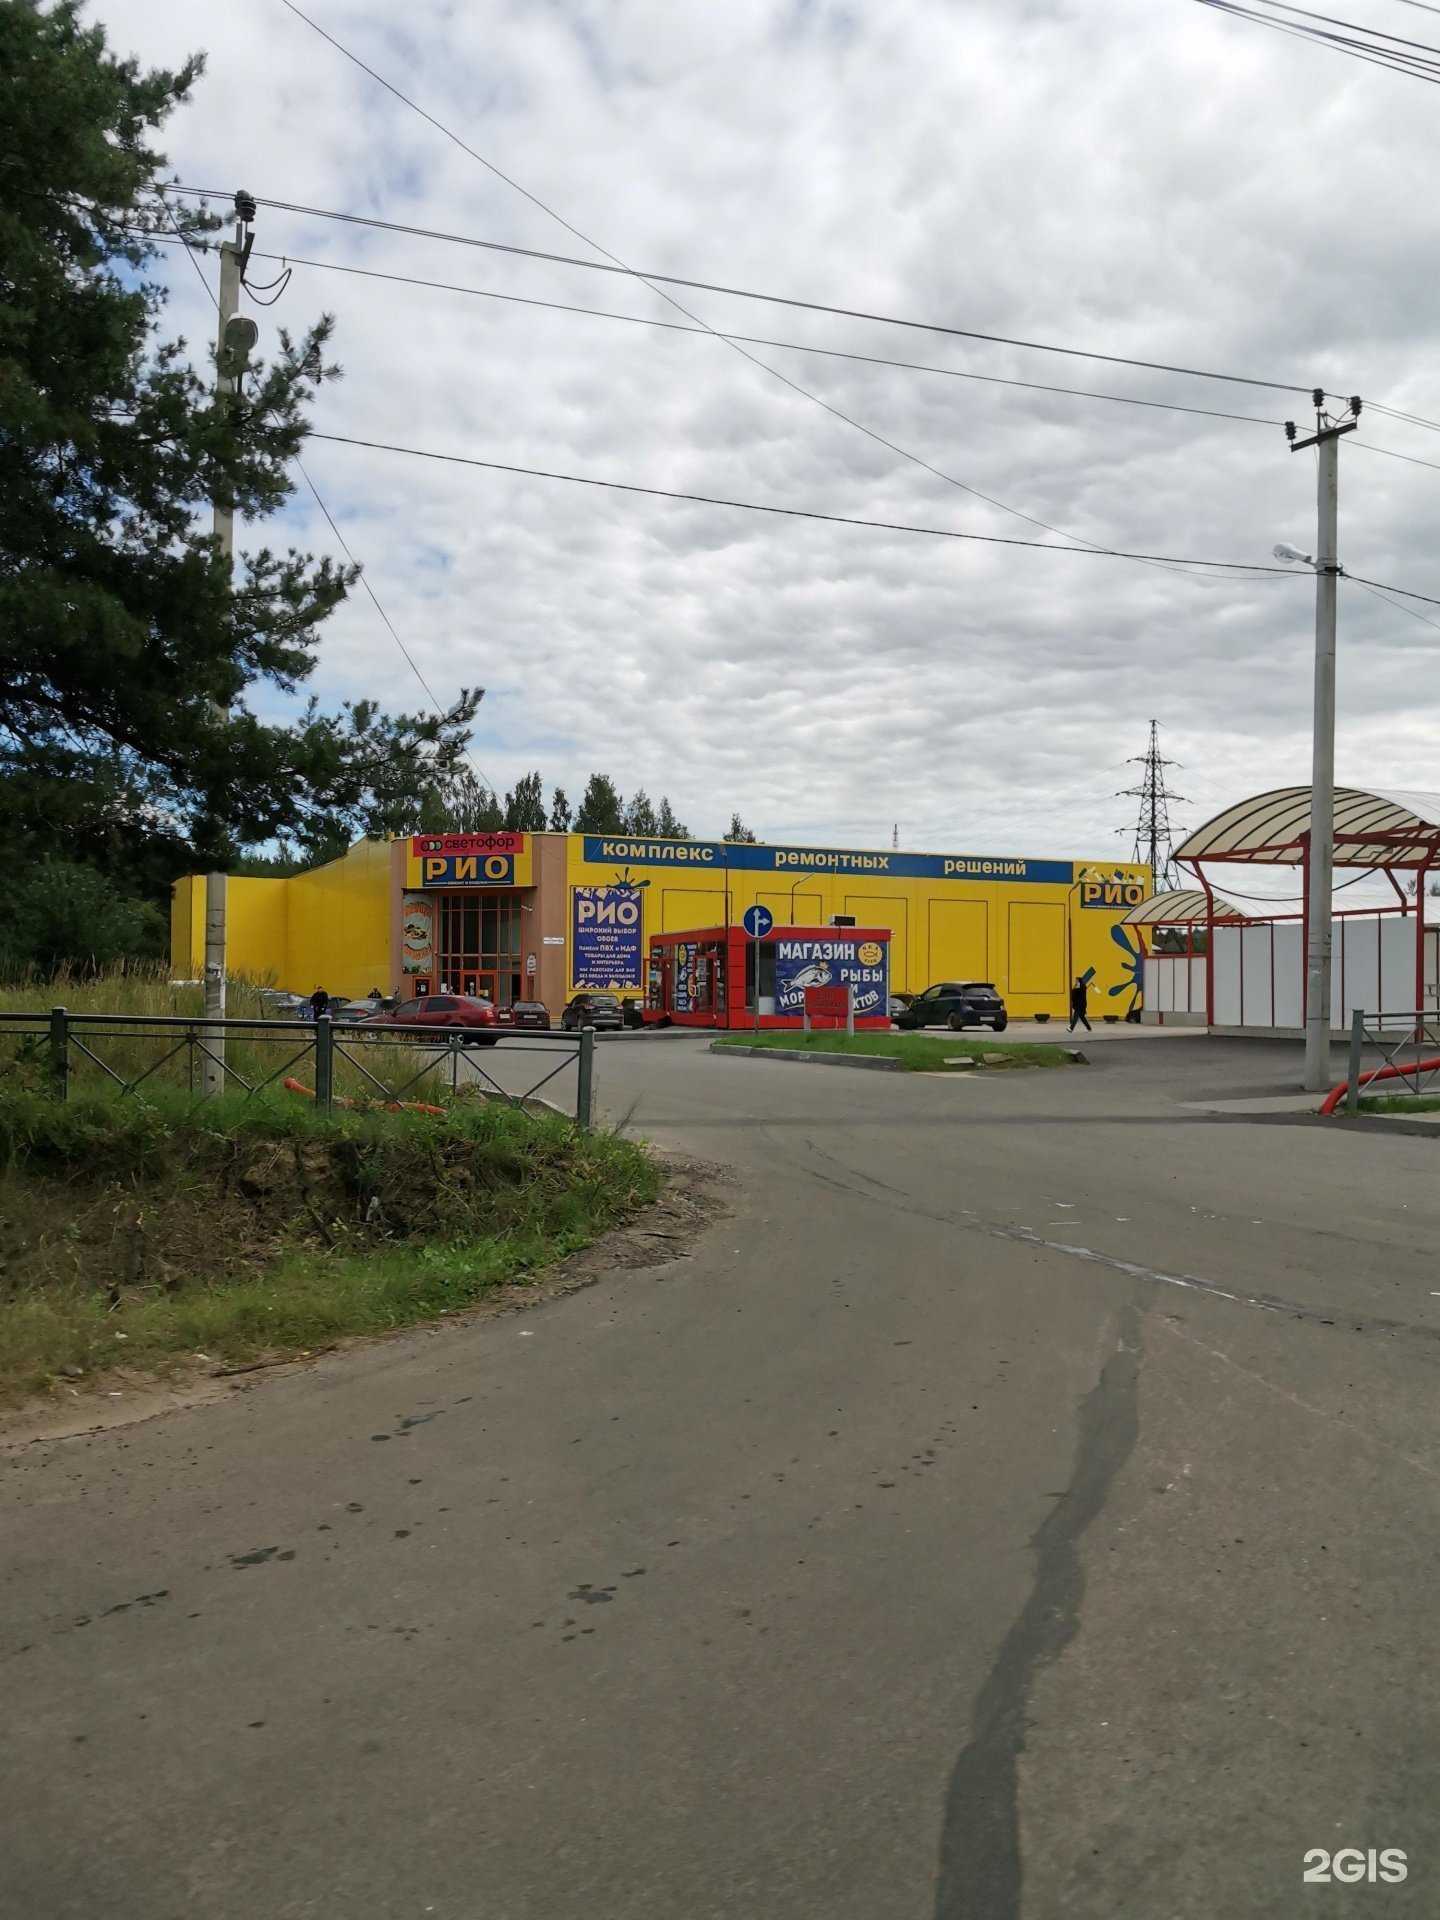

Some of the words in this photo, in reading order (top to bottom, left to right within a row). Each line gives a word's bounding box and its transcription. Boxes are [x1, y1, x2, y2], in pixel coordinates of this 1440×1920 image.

[444, 835, 515, 850] светофор
[602, 840, 713, 861] комплекс
[775, 850, 889, 869] ремонтных
[944, 858, 1027, 875] решений
[426, 856, 509, 880] РИО
[1084, 884, 1144, 905] РИО
[578, 900, 639, 925] РИО
[578, 926, 612, 934] ШИРОКИЙ
[779, 942, 855, 960] МАГАЗИН
[840, 968, 883, 982] РЫБЫ
